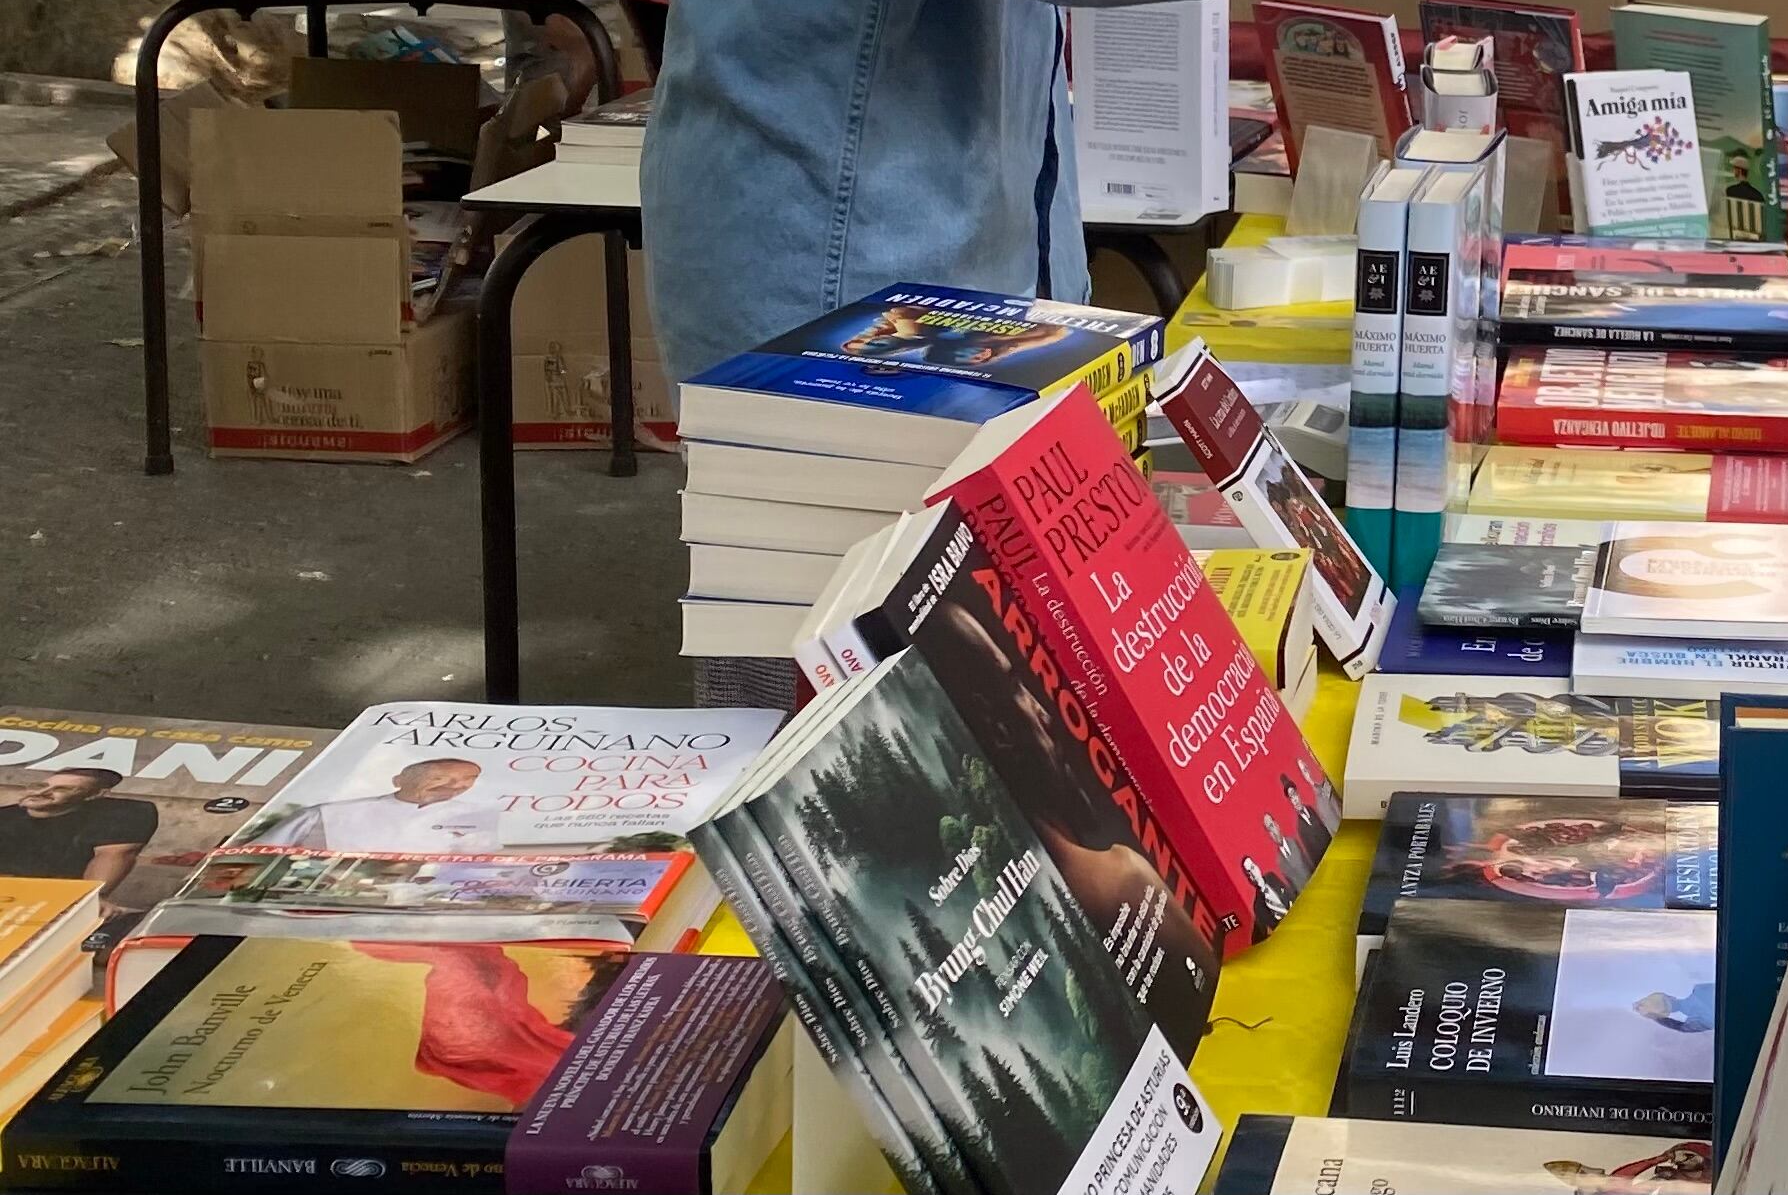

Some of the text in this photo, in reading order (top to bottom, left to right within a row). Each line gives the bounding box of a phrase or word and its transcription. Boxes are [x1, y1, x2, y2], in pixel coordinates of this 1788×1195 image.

[1586, 92, 1688, 118] Amiga mía
[885, 293, 1025, 317] McFADDEN
[1355, 330, 1396, 341] MÁXIMO
[1355, 343, 1394, 352] HUERTA
[1405, 332, 1446, 343] MÁXIMO
[1405, 345, 1444, 354] HUERTA
[1553, 419, 1666, 439] OBJETIVO VENGANZA
[1013, 440, 1089, 525] PAUL
[978, 494, 1040, 580] PAUL
[1043, 455, 1152, 578] PRESTO
[927, 520, 975, 597] ISRA BRAVO
[1091, 566, 1134, 614] La
[1032, 572, 1108, 699] La destrucción
[1111, 553, 1204, 675] destrucción
[1160, 627, 1213, 697] de la
[1616, 656, 1695, 666] HOMBRE
[1626, 650, 1685, 660] BUSCA
[0, 715, 314, 750] Cocina en casa como
[370, 710, 578, 733] KARLOS
[383, 728, 732, 752] ARGUIÑANO
[0, 728, 305, 788] DANI
[508, 754, 709, 773] COCINA
[971, 567, 1217, 949] ARROGANTE
[1200, 684, 1283, 806] en España
[496, 792, 690, 813] TODOS
[573, 772, 702, 792] PARA
[532, 818, 666, 829] que nunca fallan
[606, 812, 671, 822] recetas
[1408, 802, 1439, 860] PORTABALES
[543, 876, 648, 890] ABIERTA
[928, 865, 964, 908] Sobre
[914, 849, 1043, 1016] Byung-Chul Han
[998, 948, 1051, 1019] SIMONE WEIL
[171, 983, 257, 1048] Banville
[183, 961, 329, 1095] Nocturno de Venecia
[1386, 988, 1426, 1070] Luis Landero
[1429, 981, 1469, 1072] COLOQUIO
[1466, 967, 1507, 1073] DE INVIERNO
[128, 1052, 193, 1096] John
[1092, 1050, 1172, 1185] PRINCESA DE ASTURIAS
[1530, 1102, 1714, 1125] COLOQUIO DE INVIERNO
[224, 1158, 317, 1175] BANVILLE
